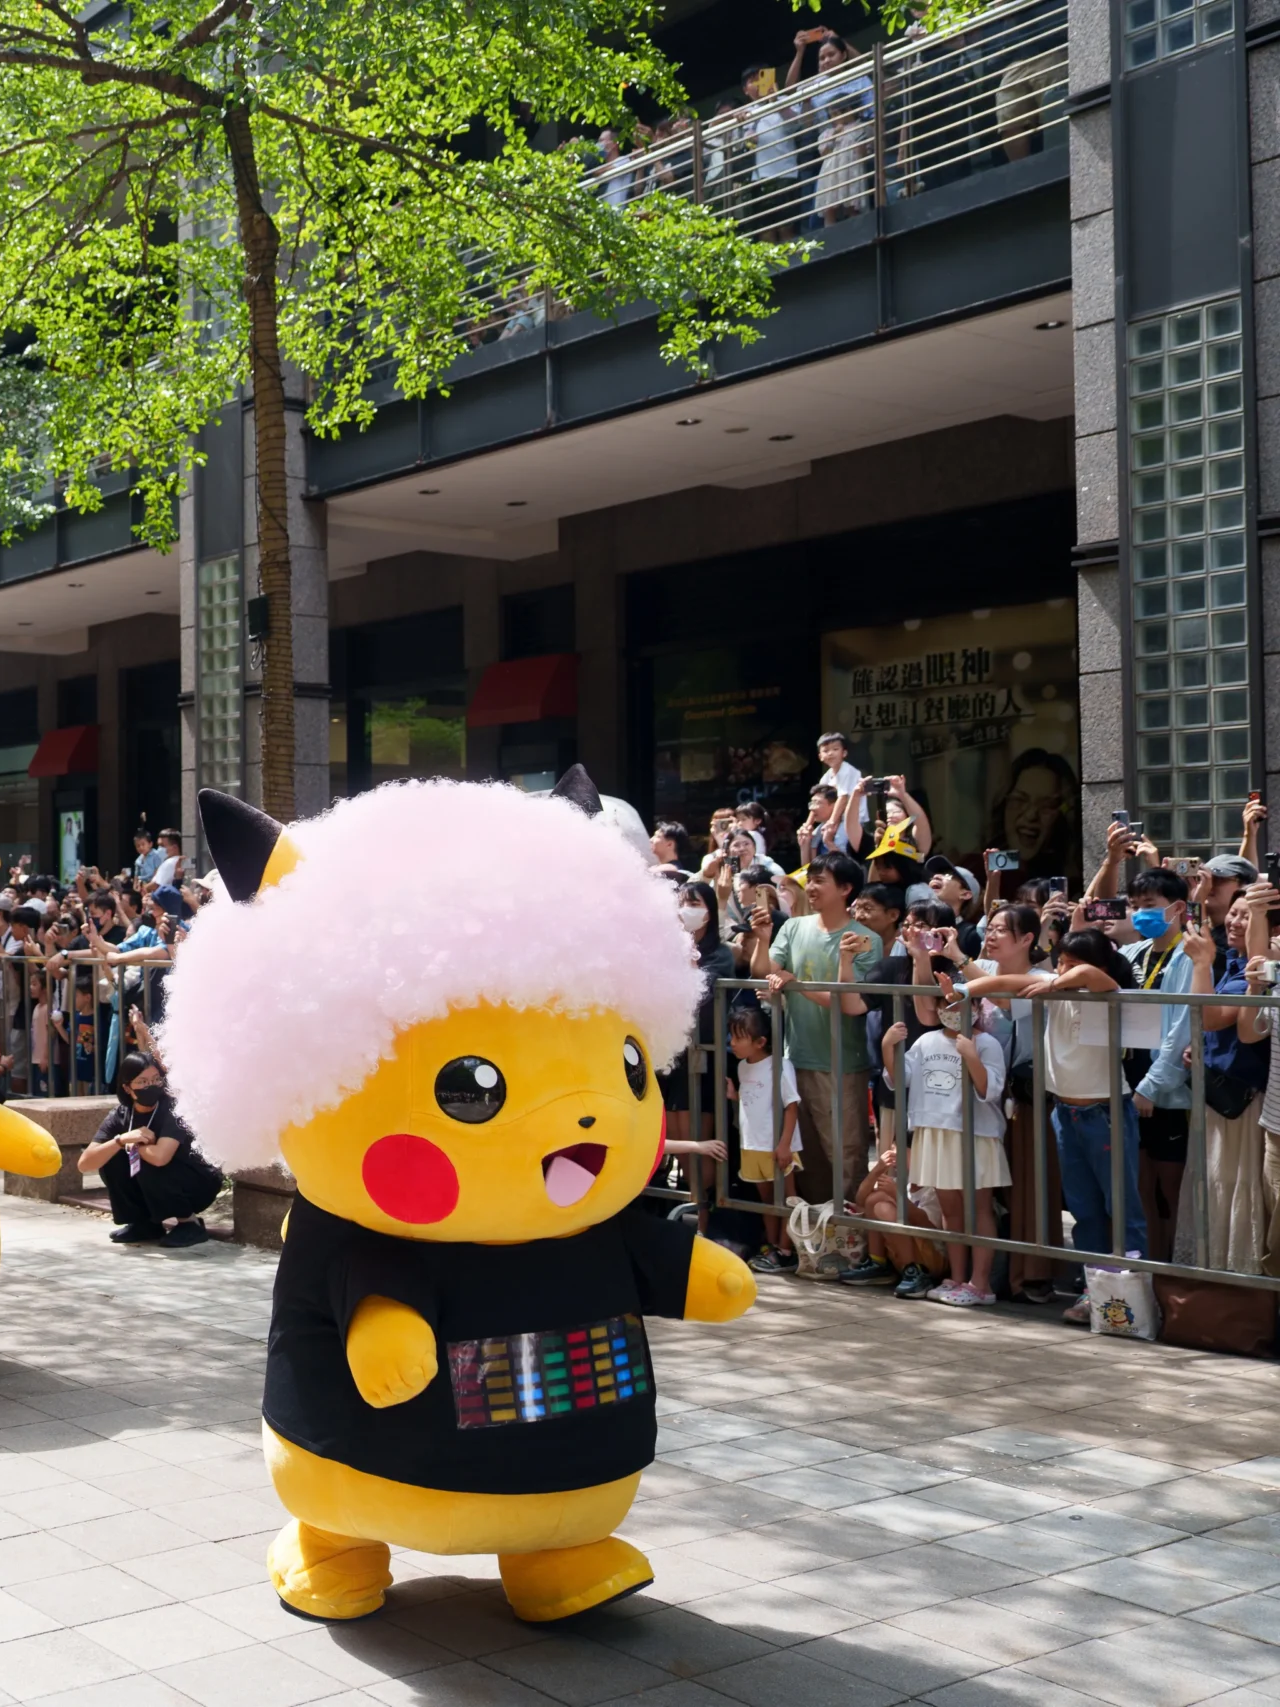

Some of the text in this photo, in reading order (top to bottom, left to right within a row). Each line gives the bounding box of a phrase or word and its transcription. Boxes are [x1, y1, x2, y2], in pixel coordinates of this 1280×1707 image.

[852, 647, 991, 695] 確認過眼神
[854, 688, 1022, 729] 是想訂餐廳的人
